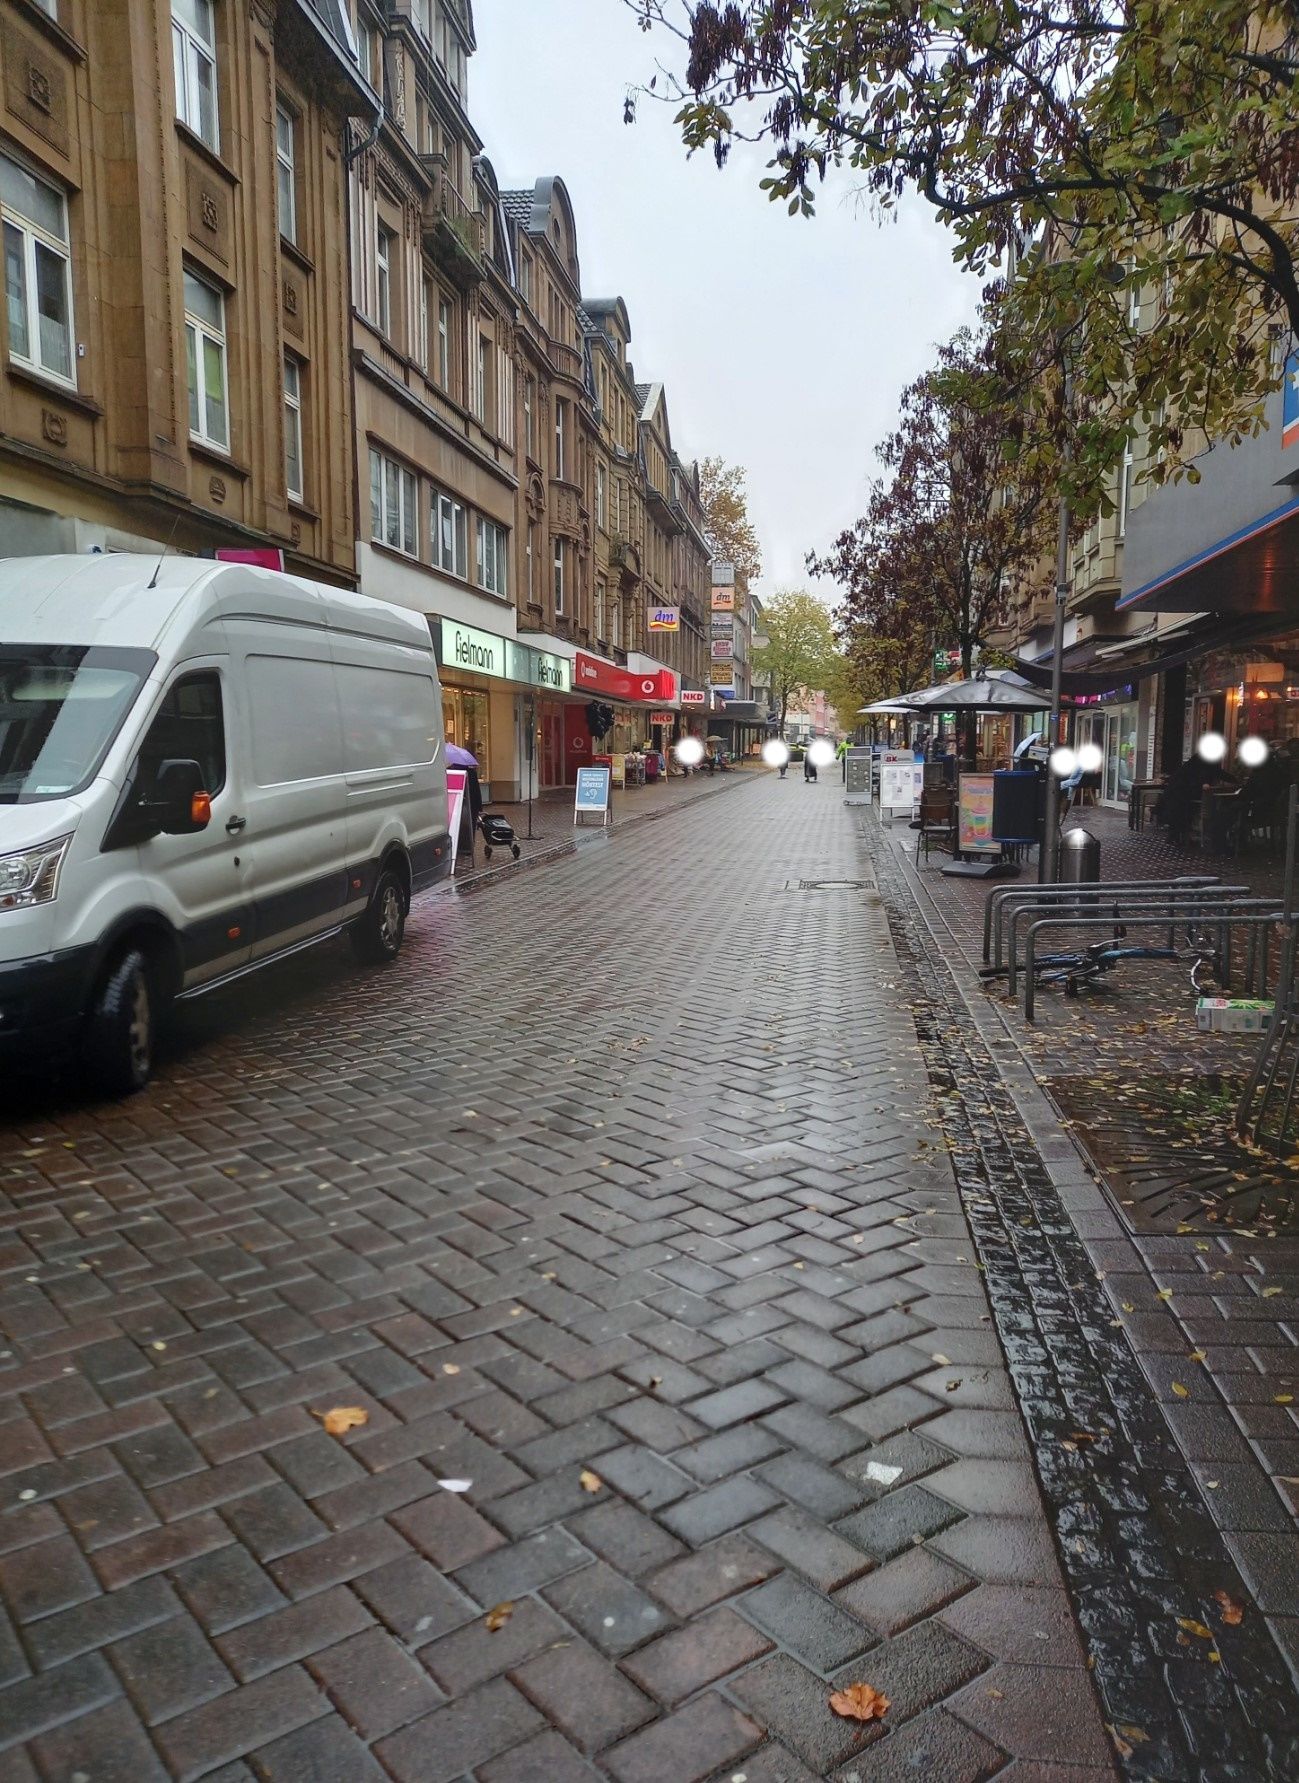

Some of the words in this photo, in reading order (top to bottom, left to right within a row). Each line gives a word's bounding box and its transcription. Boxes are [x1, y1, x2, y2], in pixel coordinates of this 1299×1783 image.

[716, 592, 731, 602] dm
[654, 610, 675, 623] dm
[455, 631, 494, 670] fielmann
[538, 657, 563, 687] fielmann
[683, 693, 703, 701] NKD
